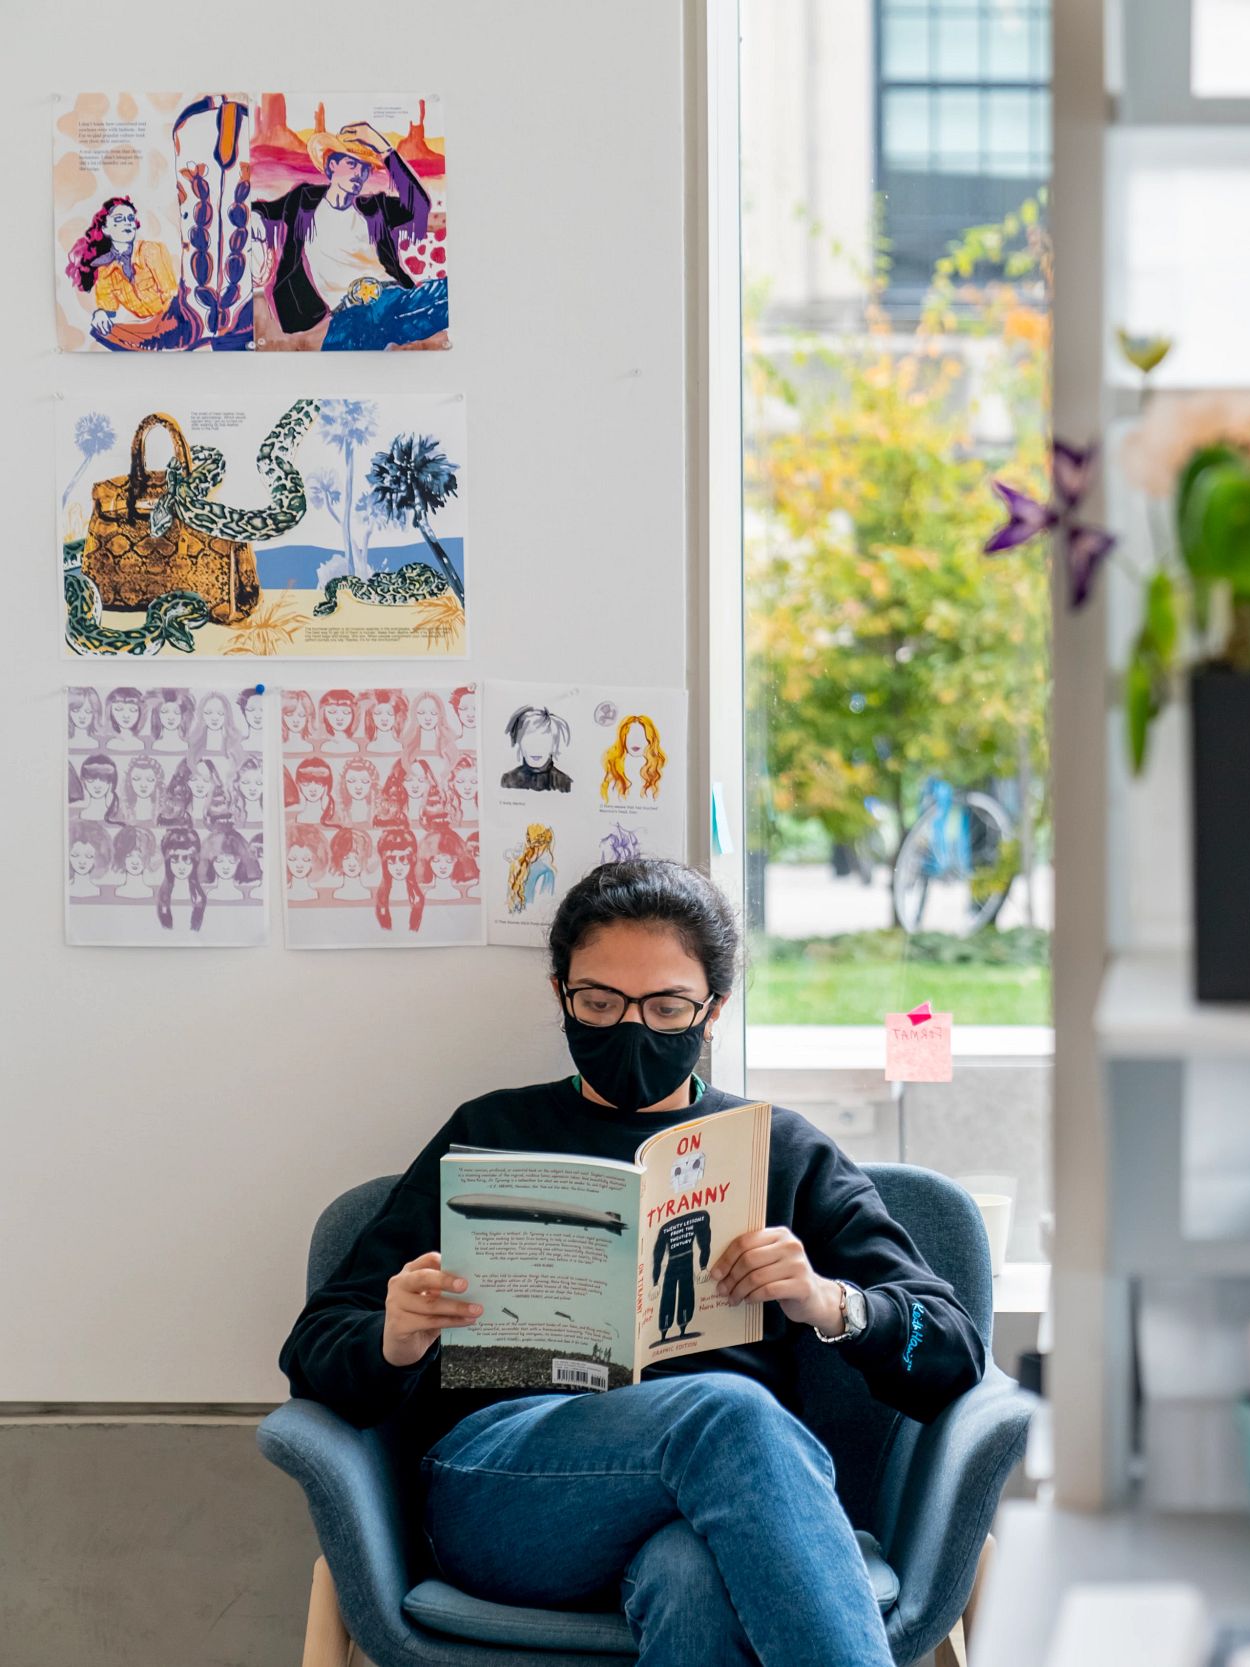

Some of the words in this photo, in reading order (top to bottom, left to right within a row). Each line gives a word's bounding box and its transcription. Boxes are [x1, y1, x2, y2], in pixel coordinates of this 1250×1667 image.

[676, 1132, 702, 1155] ON
[647, 1181, 731, 1229] TYRANNY
[663, 1222, 683, 1235] TWENTY
[683, 1215, 705, 1227] LESSONS
[670, 1228, 684, 1238] FROM
[685, 1224, 695, 1232] THE
[670, 1231, 695, 1244] TWENTIETH
[670, 1238, 692, 1250] CENTURY
